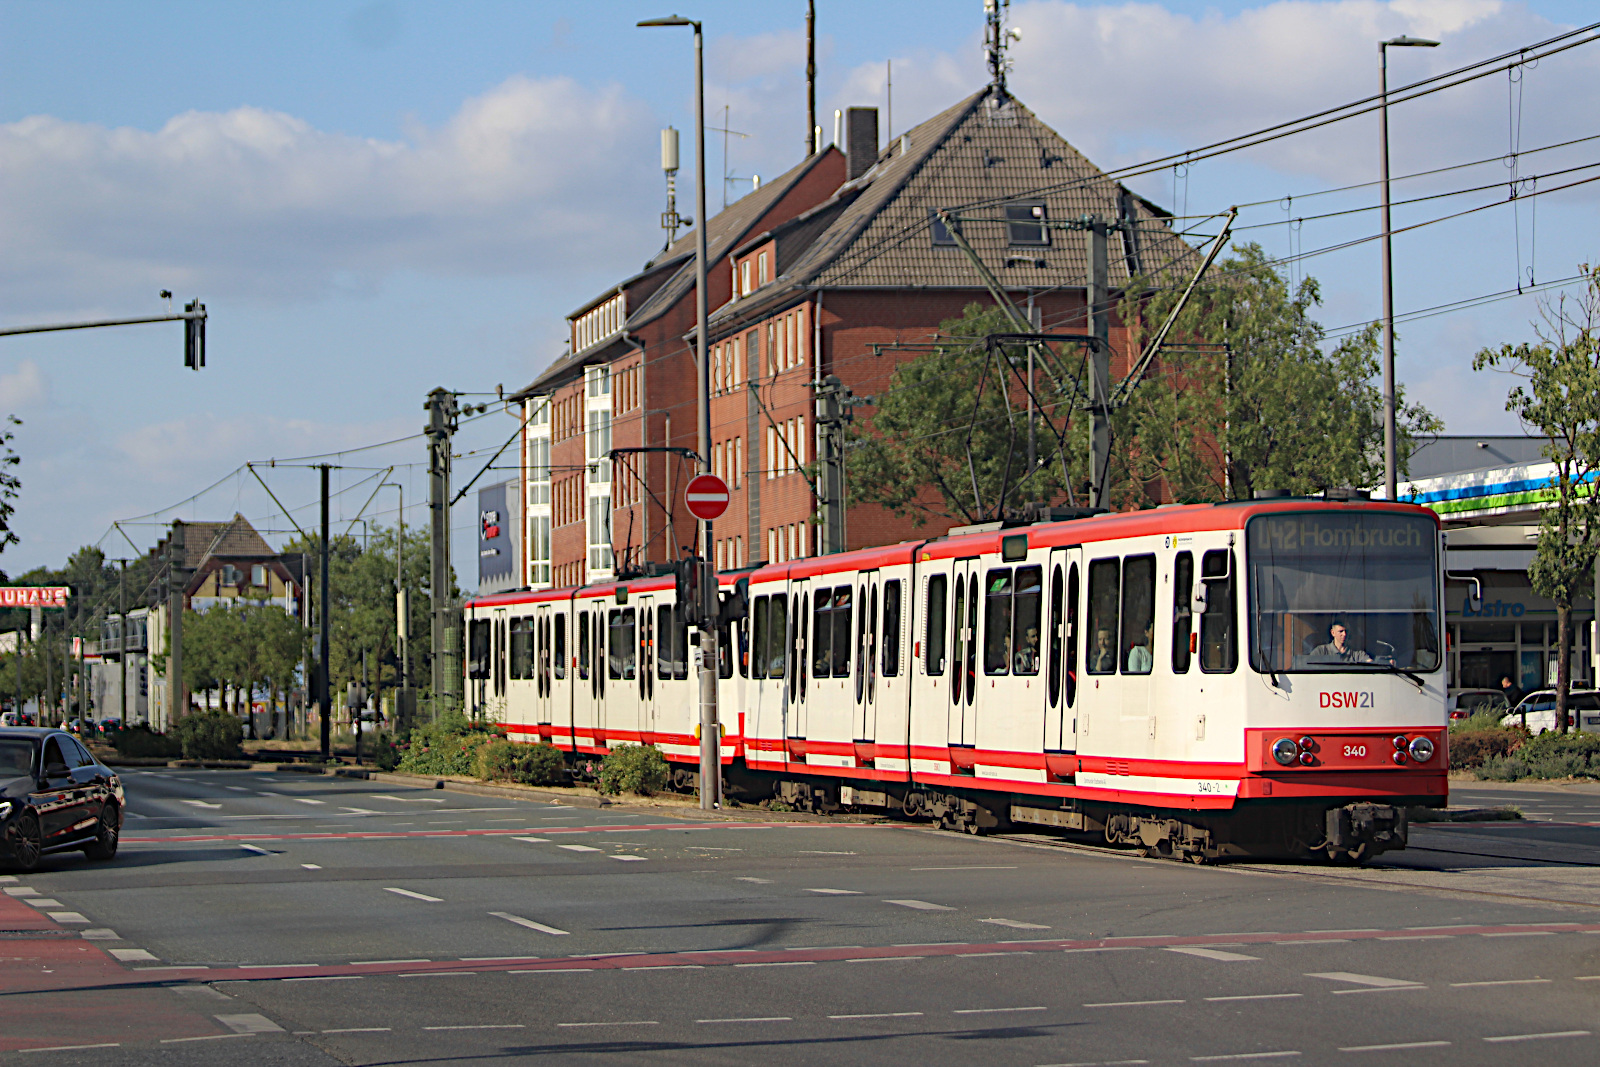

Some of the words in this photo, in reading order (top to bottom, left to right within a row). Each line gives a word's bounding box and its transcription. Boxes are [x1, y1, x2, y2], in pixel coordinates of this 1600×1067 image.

[1257, 520, 1297, 550] U42
[1299, 523, 1421, 547] Hombruch
[0, 588, 65, 602] UHAUS
[1319, 691, 1374, 708] DSW21
[1343, 745, 1366, 757] 340
[1197, 781, 1221, 793] 340-2
